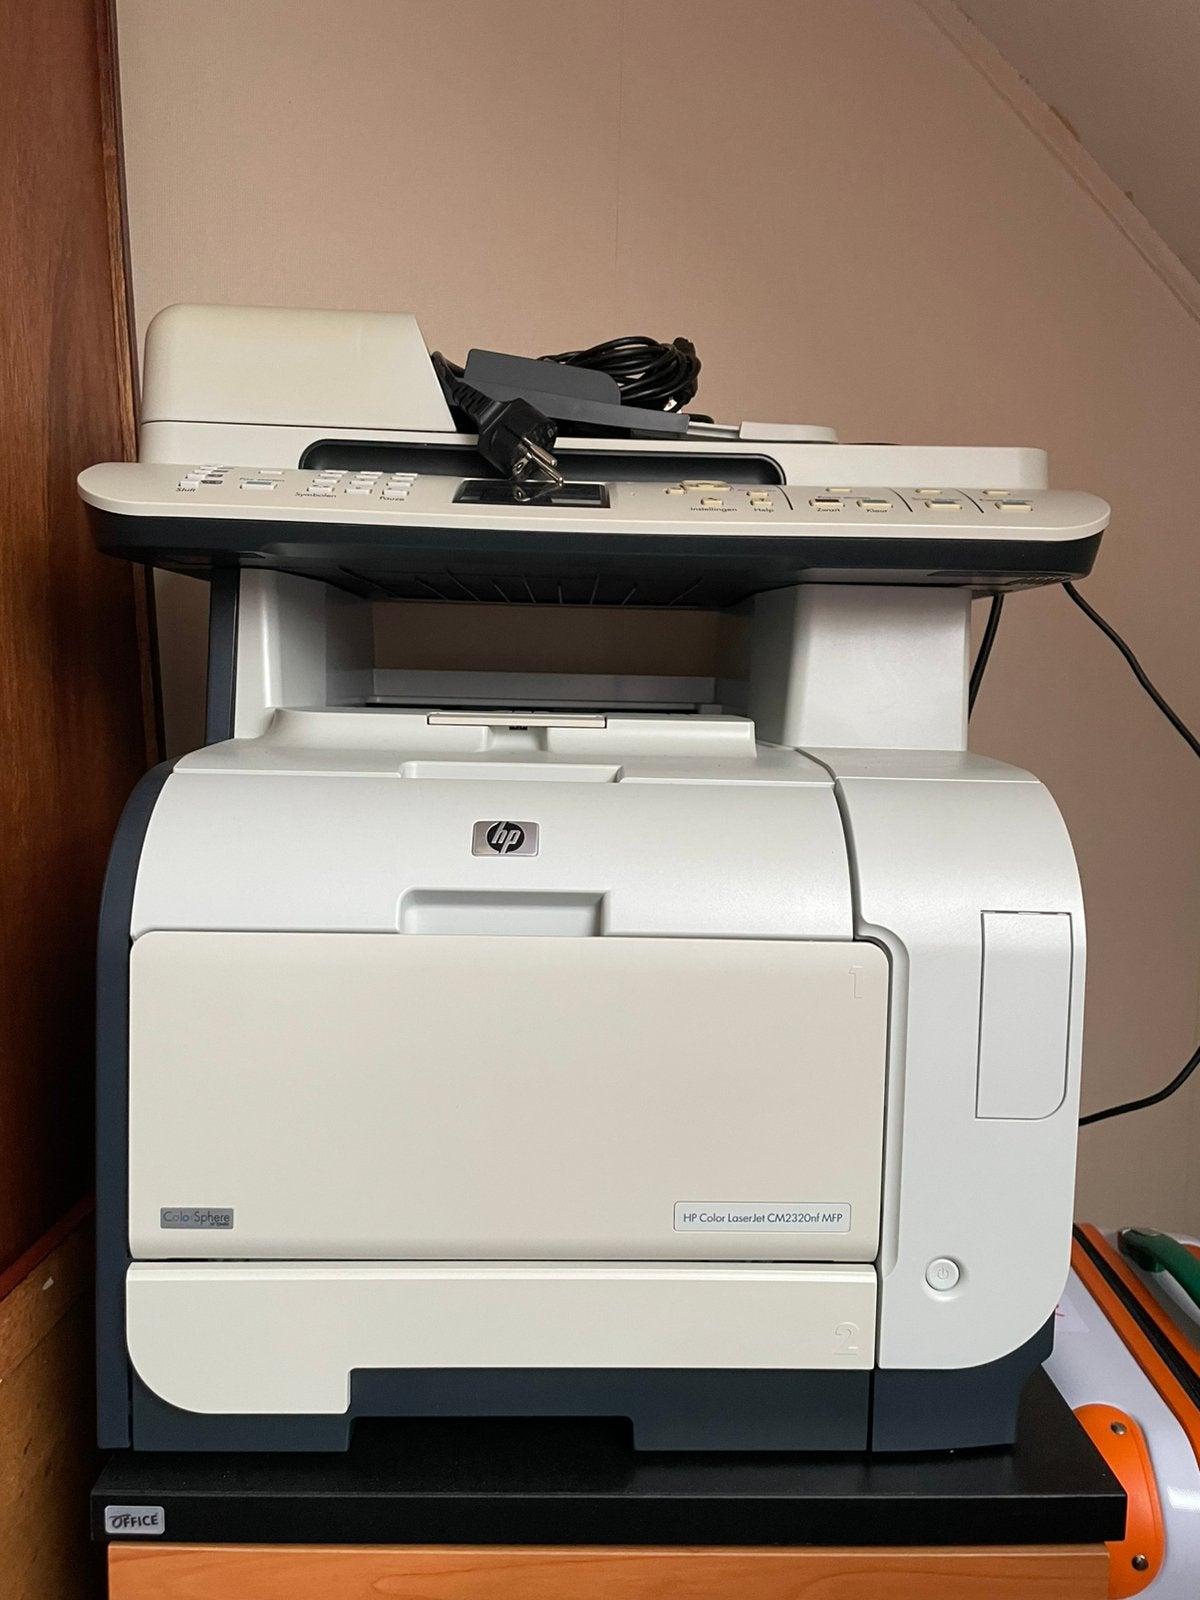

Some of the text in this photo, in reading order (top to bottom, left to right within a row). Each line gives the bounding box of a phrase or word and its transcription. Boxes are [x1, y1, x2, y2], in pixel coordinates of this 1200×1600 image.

[163, 1210, 230, 1225] ColoSphere
[683, 1212, 843, 1223] HP Color LaserJet CM2320nf MFP
[109, 1513, 159, 1528] OFFICE
